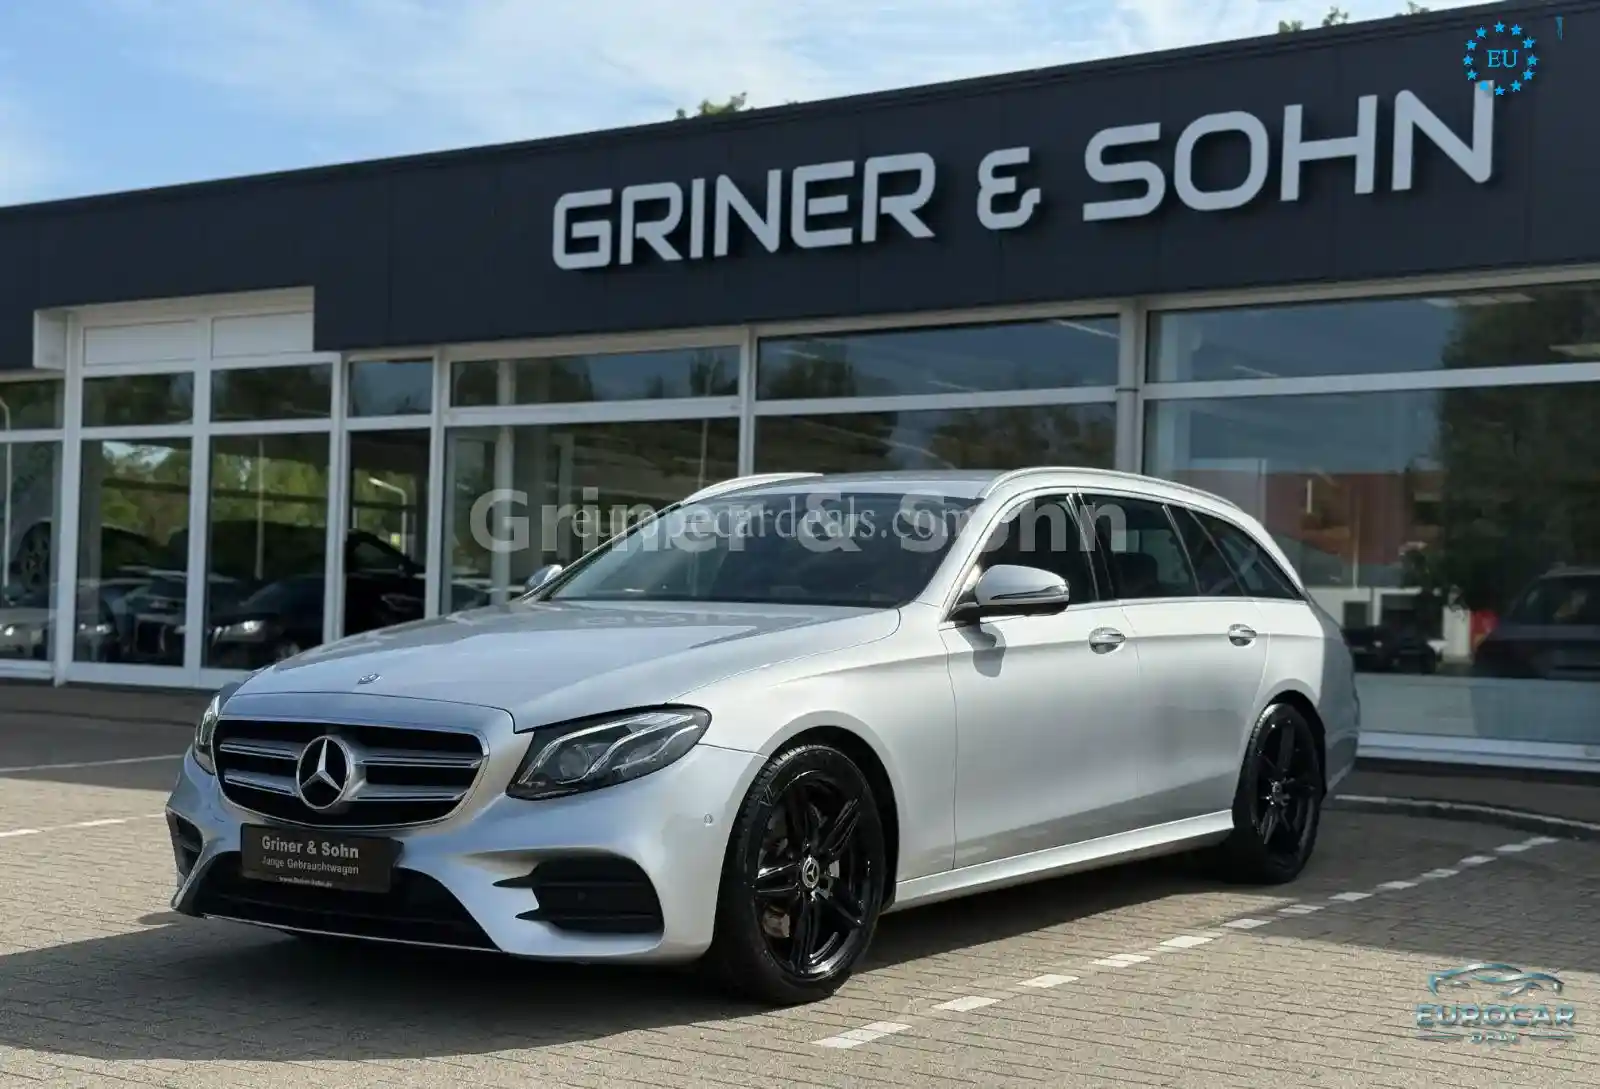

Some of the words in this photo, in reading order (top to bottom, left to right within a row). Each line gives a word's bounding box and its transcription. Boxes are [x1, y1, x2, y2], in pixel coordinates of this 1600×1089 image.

[552, 151, 937, 270] GRINER
[976, 146, 1042, 230] &
[1082, 80, 1495, 222] SOHN
[261, 834, 303, 853] Griner
[306, 840, 318, 855] &
[321, 841, 360, 859] Sohn
